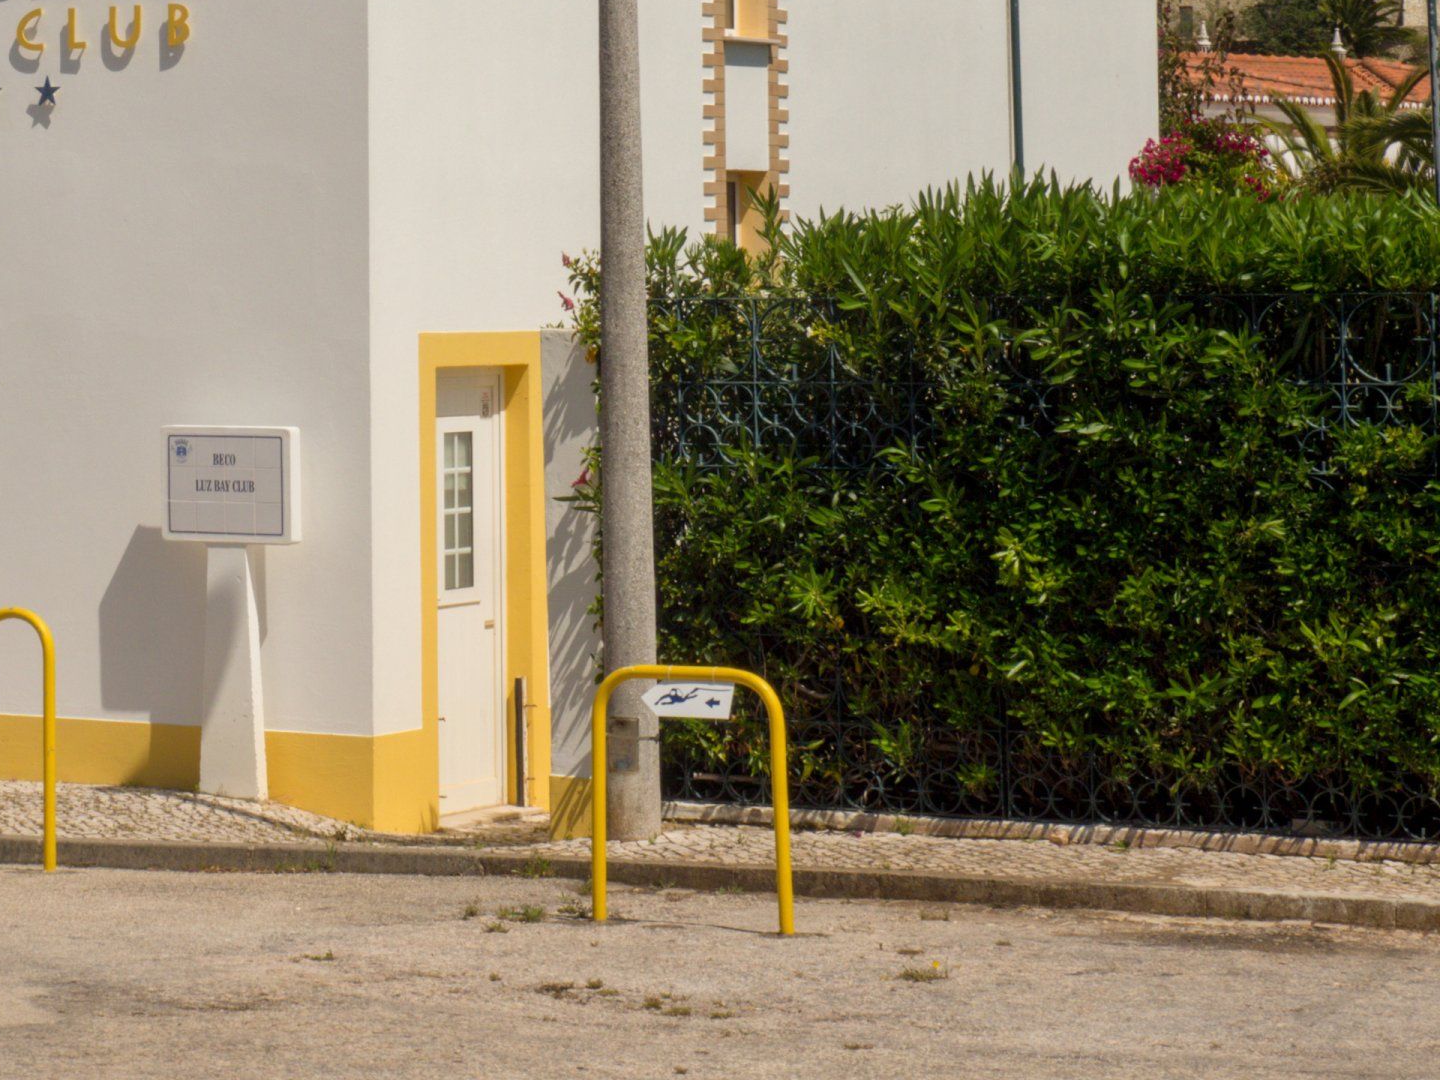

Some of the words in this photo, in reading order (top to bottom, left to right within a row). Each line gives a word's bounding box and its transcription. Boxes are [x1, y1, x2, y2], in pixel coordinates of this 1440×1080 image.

[16, 3, 192, 53] CLUB
[212, 453, 236, 466] BECO
[195, 479, 212, 492] LUZ
[214, 480, 231, 493] BAY
[232, 480, 255, 493] CLUB
